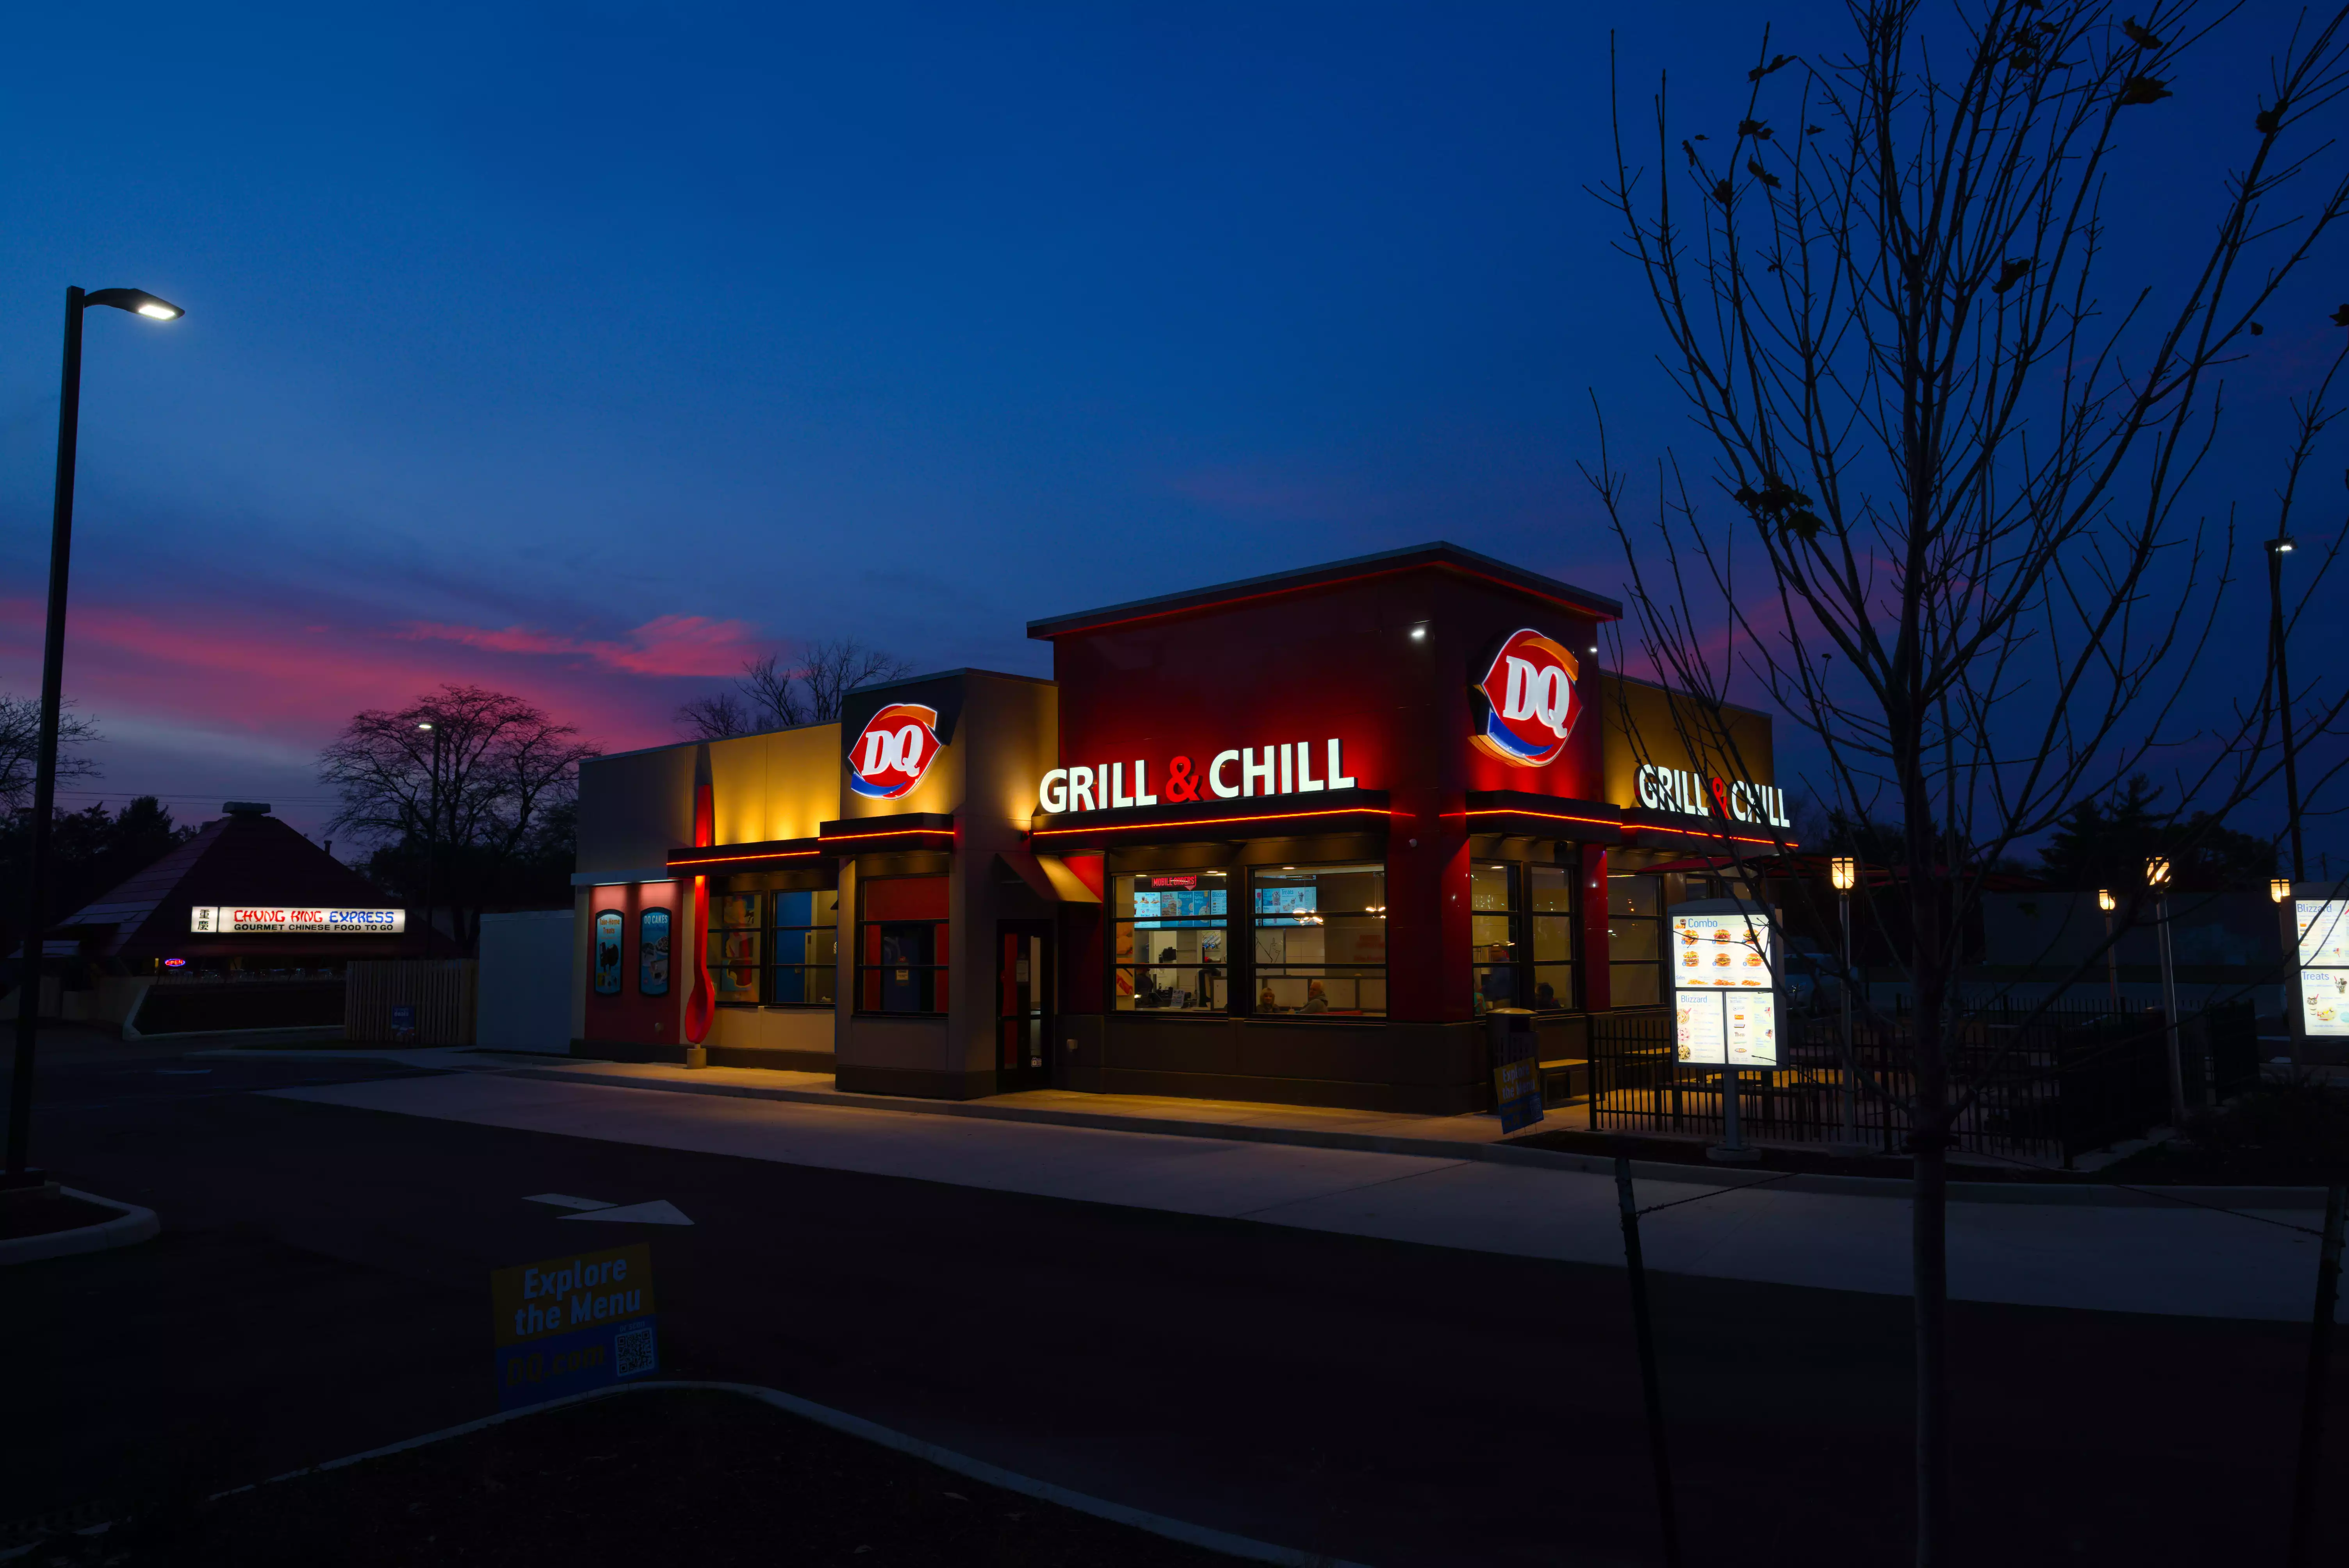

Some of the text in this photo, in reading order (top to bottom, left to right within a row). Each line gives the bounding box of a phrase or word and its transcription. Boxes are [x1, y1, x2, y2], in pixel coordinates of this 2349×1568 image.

[1502, 655, 1570, 739] DQ
[861, 725, 923, 777] DQ
[1039, 738, 1355, 813] GRILL & CHILL
[1639, 764, 1709, 816] GRILL
[1153, 876, 1194, 886] MOBILE ORDERS
[234, 910, 394, 923] CHUNG KING EXPRESS
[2297, 903, 2332, 912] Blizzad
[198, 909, 210, 930] 重慶
[644, 915, 668, 925] DQ CAKES
[1688, 918, 1718, 928] Combo
[2301, 971, 2329, 980] Treats
[1502, 1065, 1530, 1084] Explore
[1502, 1079, 1535, 1099] the Menu
[524, 1259, 627, 1301] Explore
[514, 1288, 641, 1336] the Menu
[628, 1320, 645, 1331] scan
[507, 1345, 604, 1387] DQ.com
